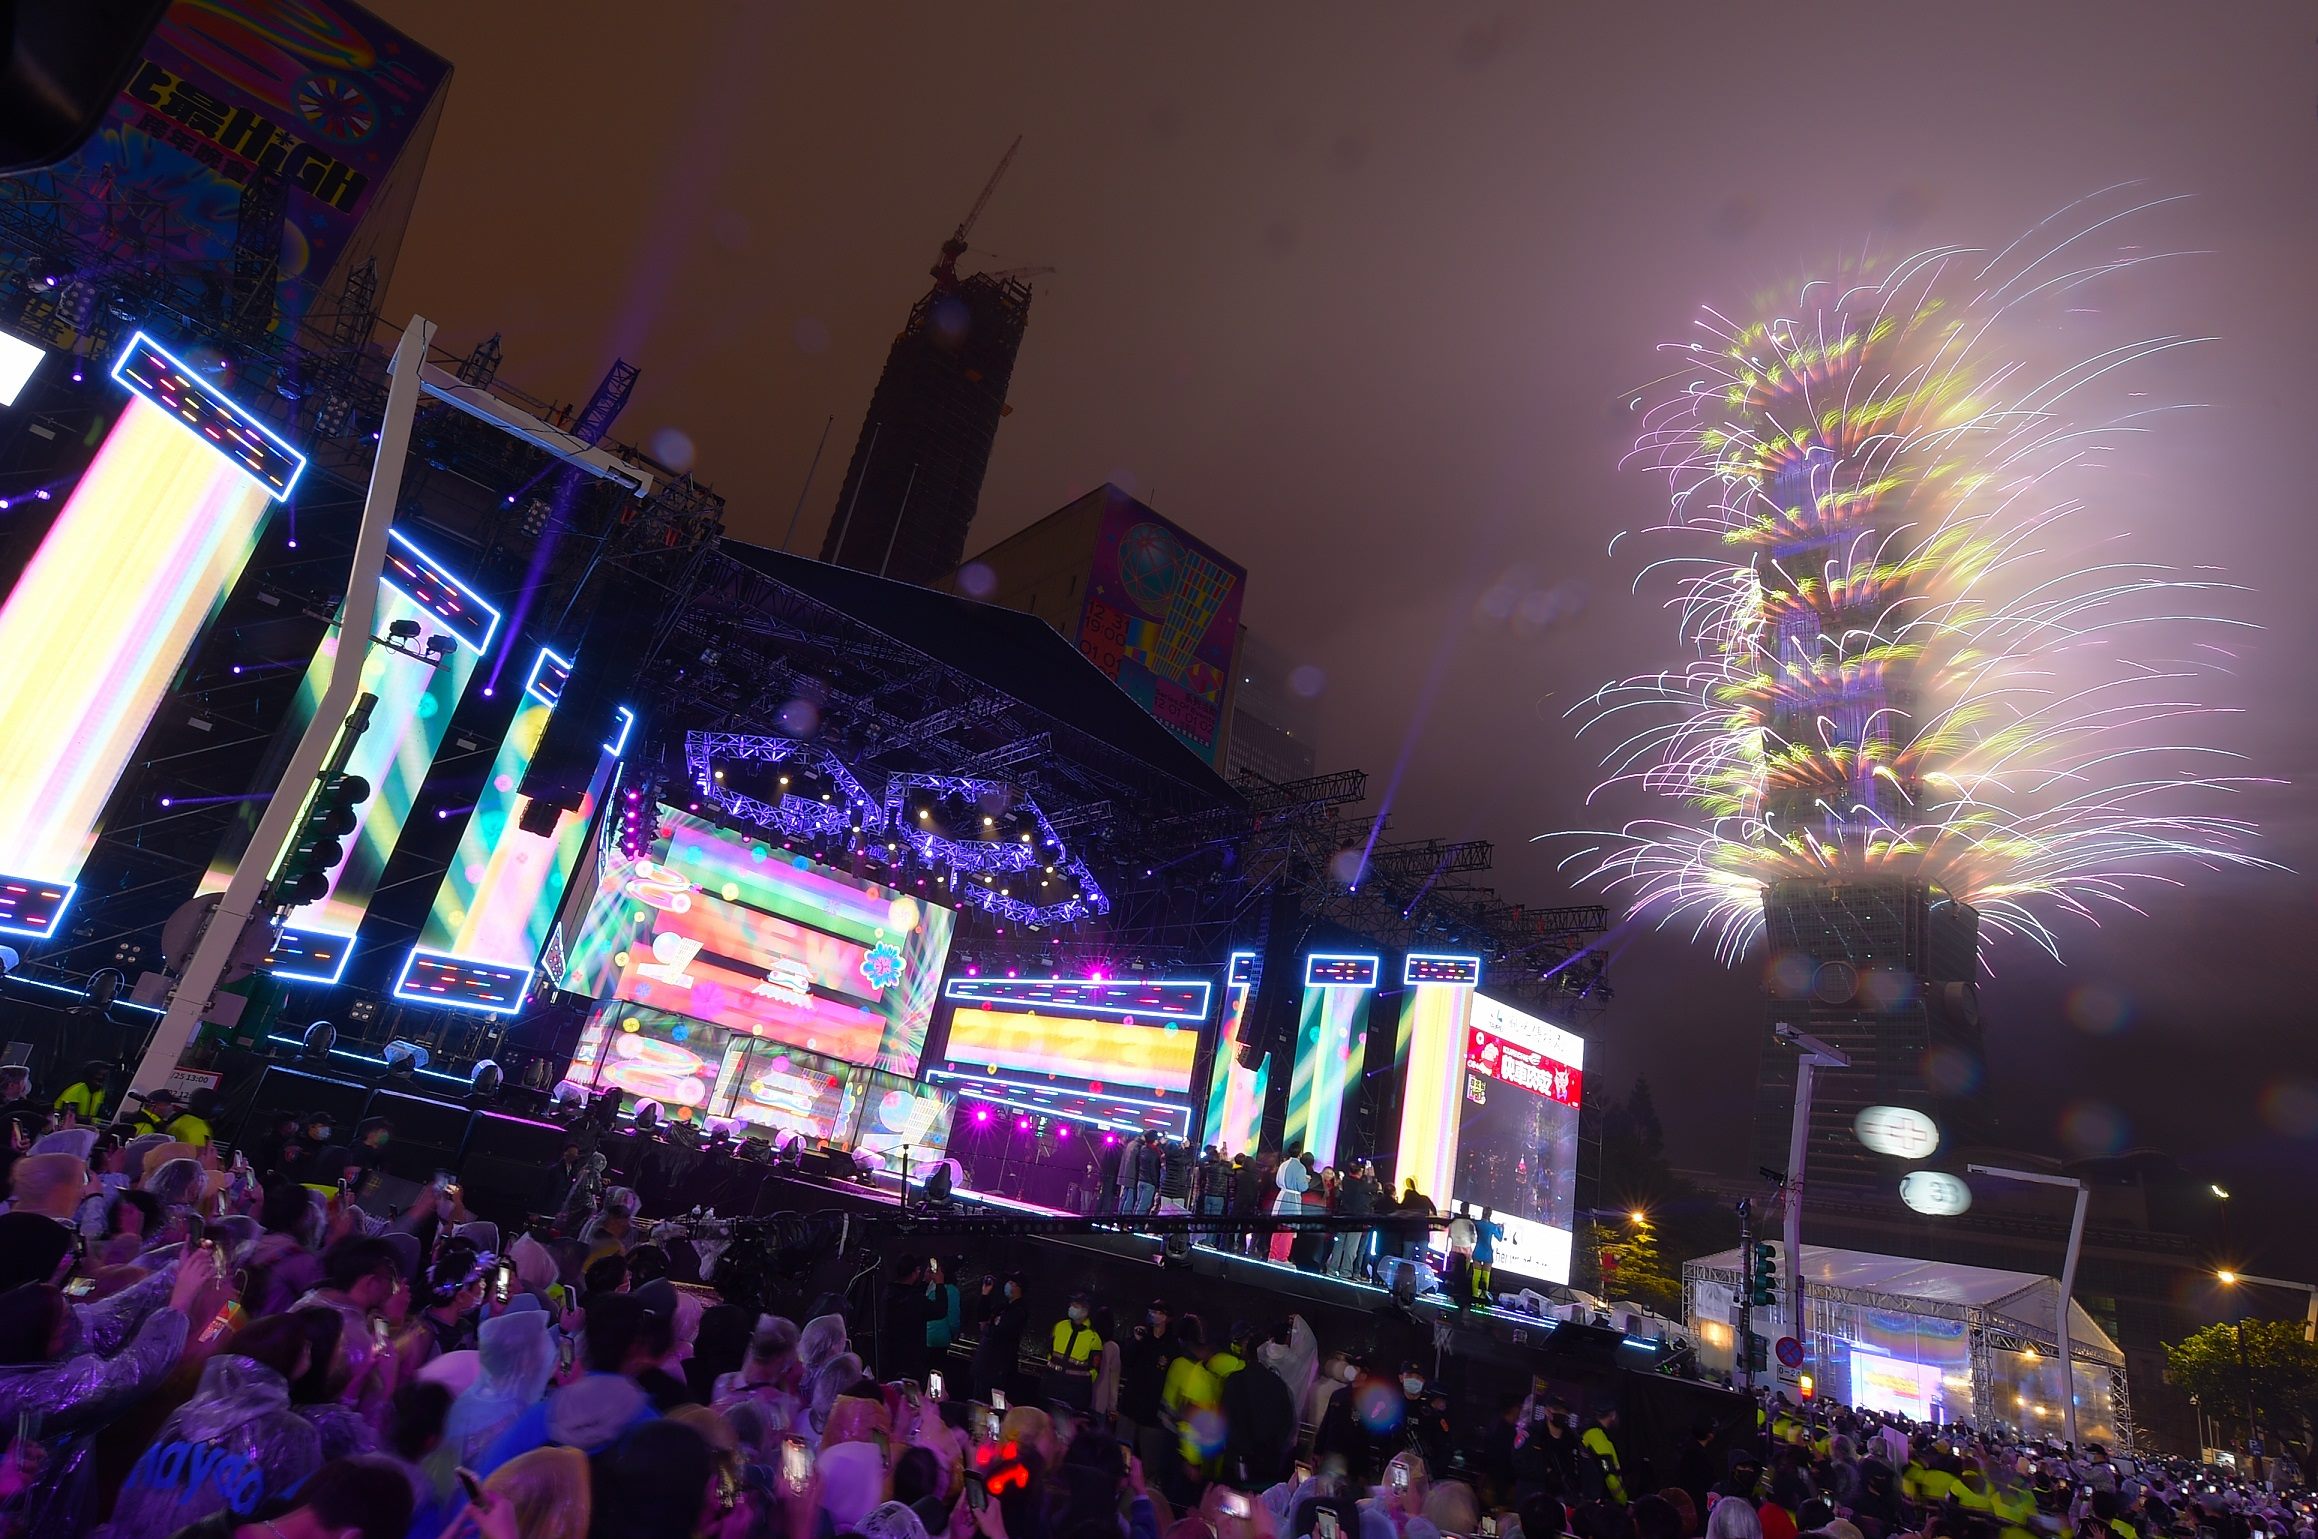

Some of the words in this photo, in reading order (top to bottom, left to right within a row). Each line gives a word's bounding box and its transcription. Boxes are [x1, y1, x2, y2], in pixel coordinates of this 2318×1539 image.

[136, 112, 251, 185] 跨年晚會
[1085, 615, 1126, 647] 19:00
[1089, 600, 1105, 620] 12
[1112, 614, 1129, 632] 31
[1103, 652, 1122, 673] 01
[186, 1074, 209, 1084] 13:00
